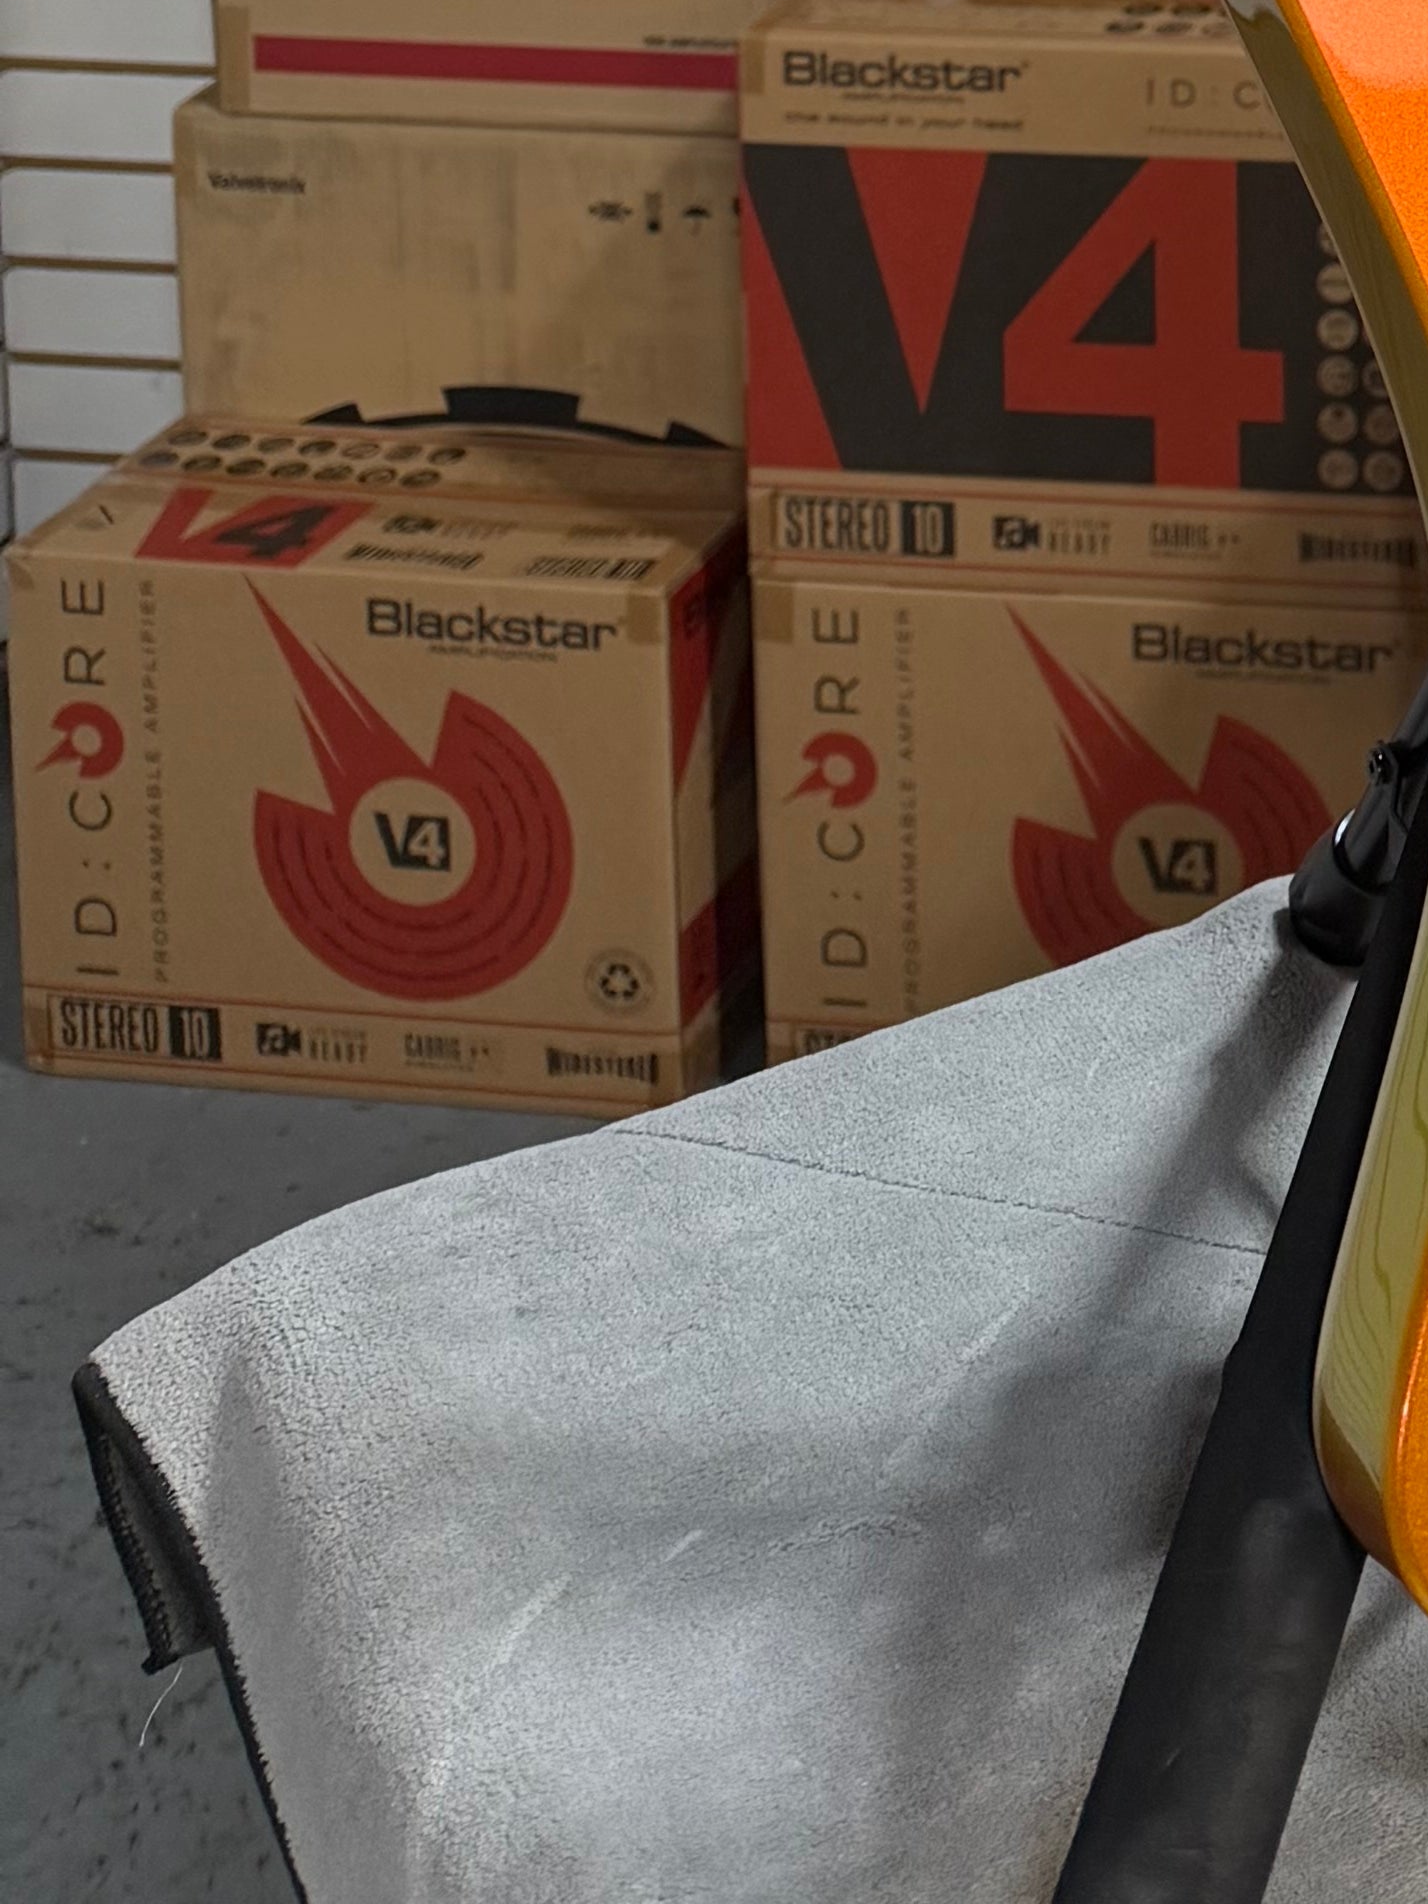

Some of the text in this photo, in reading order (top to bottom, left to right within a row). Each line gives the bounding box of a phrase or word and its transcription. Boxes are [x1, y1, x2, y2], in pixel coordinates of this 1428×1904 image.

[782, 50, 1022, 93] Blackstar
[744, 144, 1286, 487] V4
[784, 494, 890, 553] STEREO
[366, 597, 619, 651] Blackstar
[1132, 622, 1394, 674] Blackstar
[139, 578, 160, 734] AMPLIFIER
[373, 810, 451, 873] V4
[1138, 836, 1217, 895] V4
[60, 996, 160, 1055] STEREO
